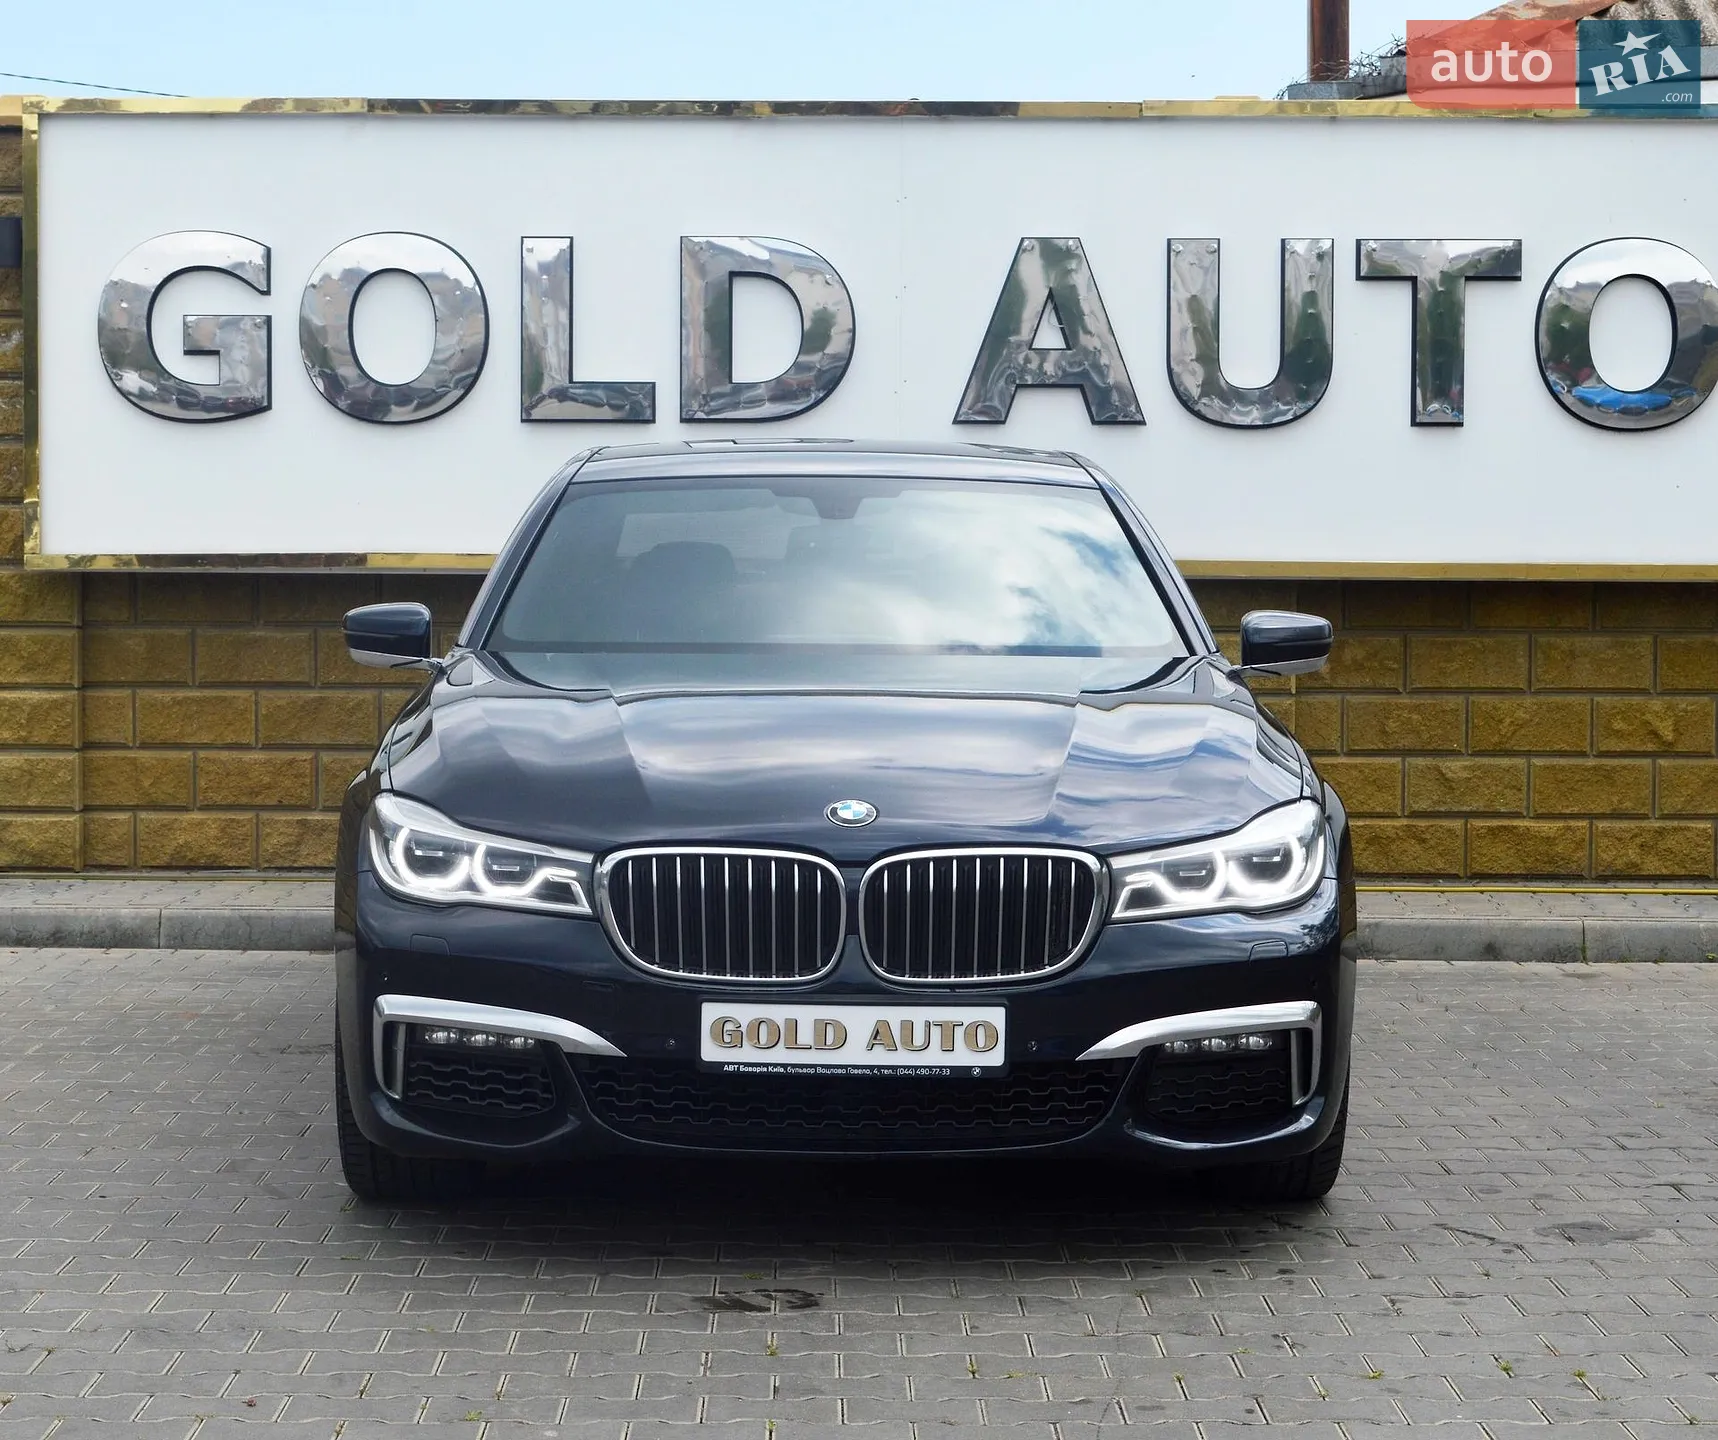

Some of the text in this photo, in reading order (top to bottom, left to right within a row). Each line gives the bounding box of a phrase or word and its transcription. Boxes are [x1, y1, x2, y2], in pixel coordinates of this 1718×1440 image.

[97, 229, 1718, 432] GOLD AUTO
[709, 1015, 999, 1053] GOLD AUTO
[897, 1067, 915, 1076] (044)
[916, 1068, 951, 1076] 490-77-33
